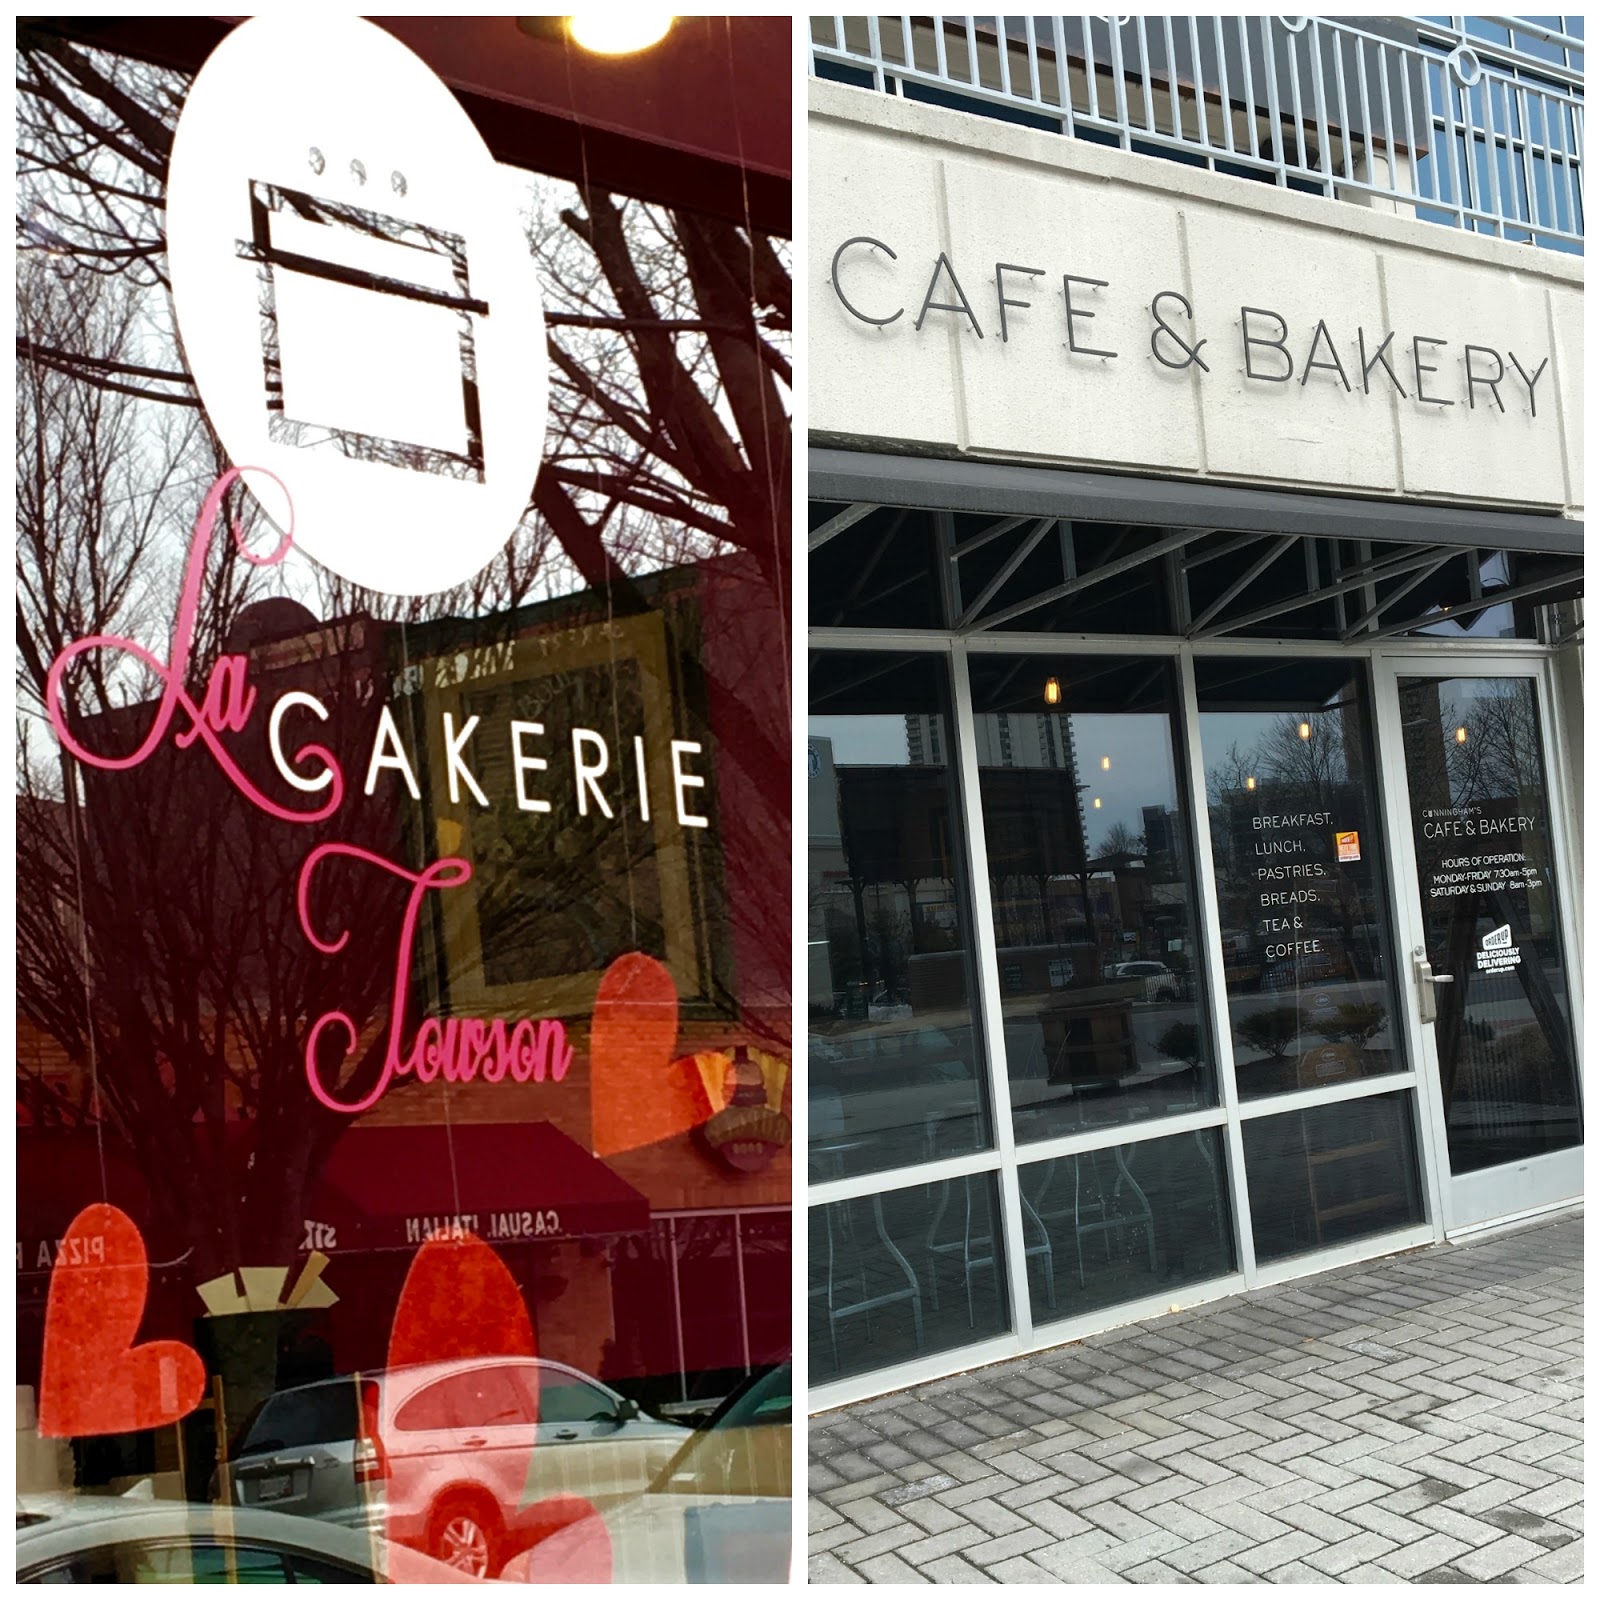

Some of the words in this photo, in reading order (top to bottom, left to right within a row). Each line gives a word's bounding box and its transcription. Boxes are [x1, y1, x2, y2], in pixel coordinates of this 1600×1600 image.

[830, 235, 1118, 358] CAFE
[1150, 290, 1210, 371] &
[1240, 305, 1549, 418] BAKERY
[47, 465, 344, 822] La
[268, 691, 709, 827] CAKERIE
[1252, 812, 1334, 830] BREAKFAST.
[1422, 806, 1482, 818] CUNNINGHAM'S
[1423, 821, 1463, 839] CAFE
[1465, 820, 1476, 836] &
[1479, 816, 1536, 835] BAKERY
[1255, 840, 1306, 856] LUNCH.
[1441, 857, 1471, 869] HOURS
[1471, 855, 1482, 867] OF
[1257, 863, 1327, 881] PASTRIES.
[1260, 889, 1321, 907] BREADS.
[1430, 885, 1470, 898] SATURDAY
[1470, 883, 1476, 894] &
[1476, 881, 1507, 893] SUNDAY
[1263, 917, 1291, 933] TEA
[1293, 916, 1304, 929] &
[1265, 939, 1325, 958] COFFEE.
[1476, 946, 1520, 960] DELICIOUSLY
[1477, 955, 1521, 969] DELIVERING
[300, 843, 574, 1114] Towson
